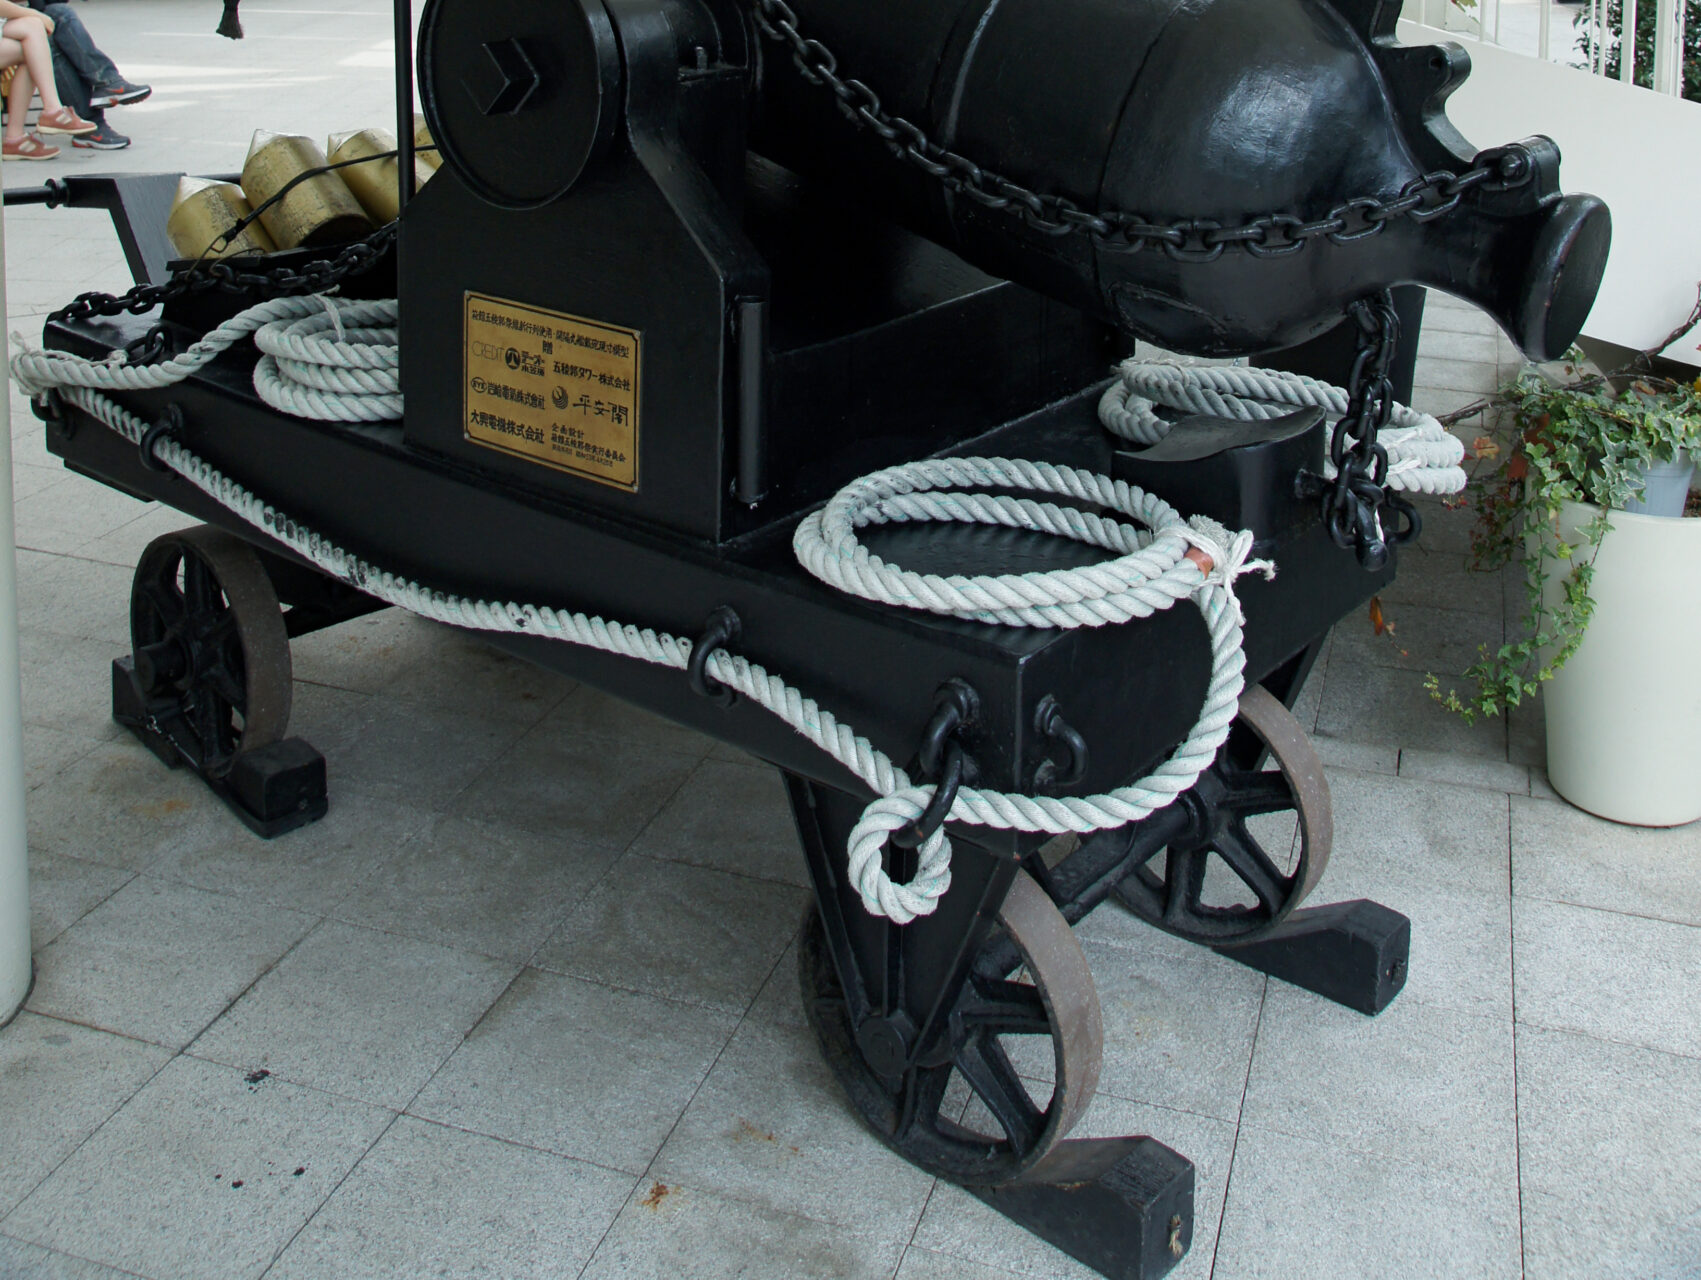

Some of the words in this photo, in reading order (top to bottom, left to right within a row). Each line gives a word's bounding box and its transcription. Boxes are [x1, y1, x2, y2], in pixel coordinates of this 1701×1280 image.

[553, 360, 631, 392] 五稜郭タワー株式会社
[573, 394, 629, 426] 平安閣
